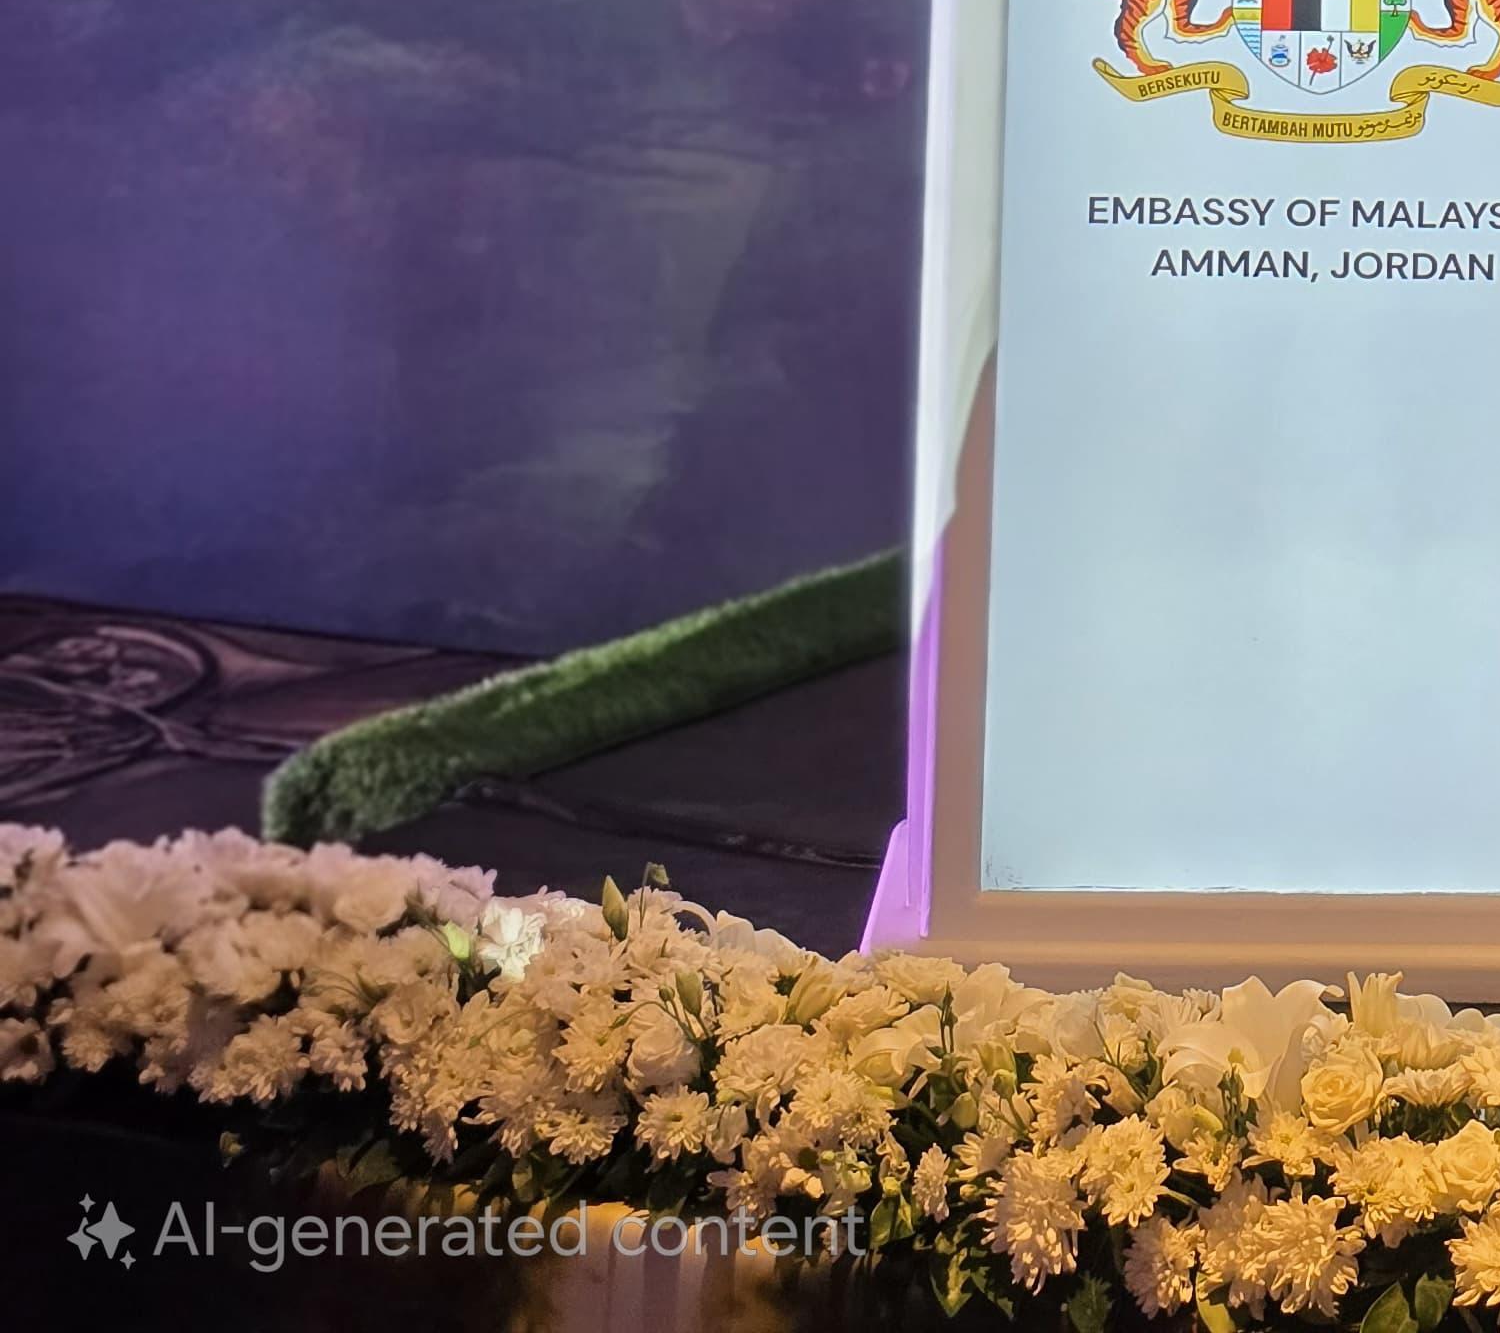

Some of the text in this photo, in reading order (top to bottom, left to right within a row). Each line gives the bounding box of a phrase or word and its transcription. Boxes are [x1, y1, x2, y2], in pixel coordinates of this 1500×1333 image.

[1138, 71, 1221, 98] BERSEKUTU
[1222, 112, 1353, 138] BERTAMBAH MUTU
[1088, 196, 1275, 226] EMBASSY
[1286, 199, 1341, 226] OF
[1151, 249, 1494, 282] AMMAN, JORDAN
